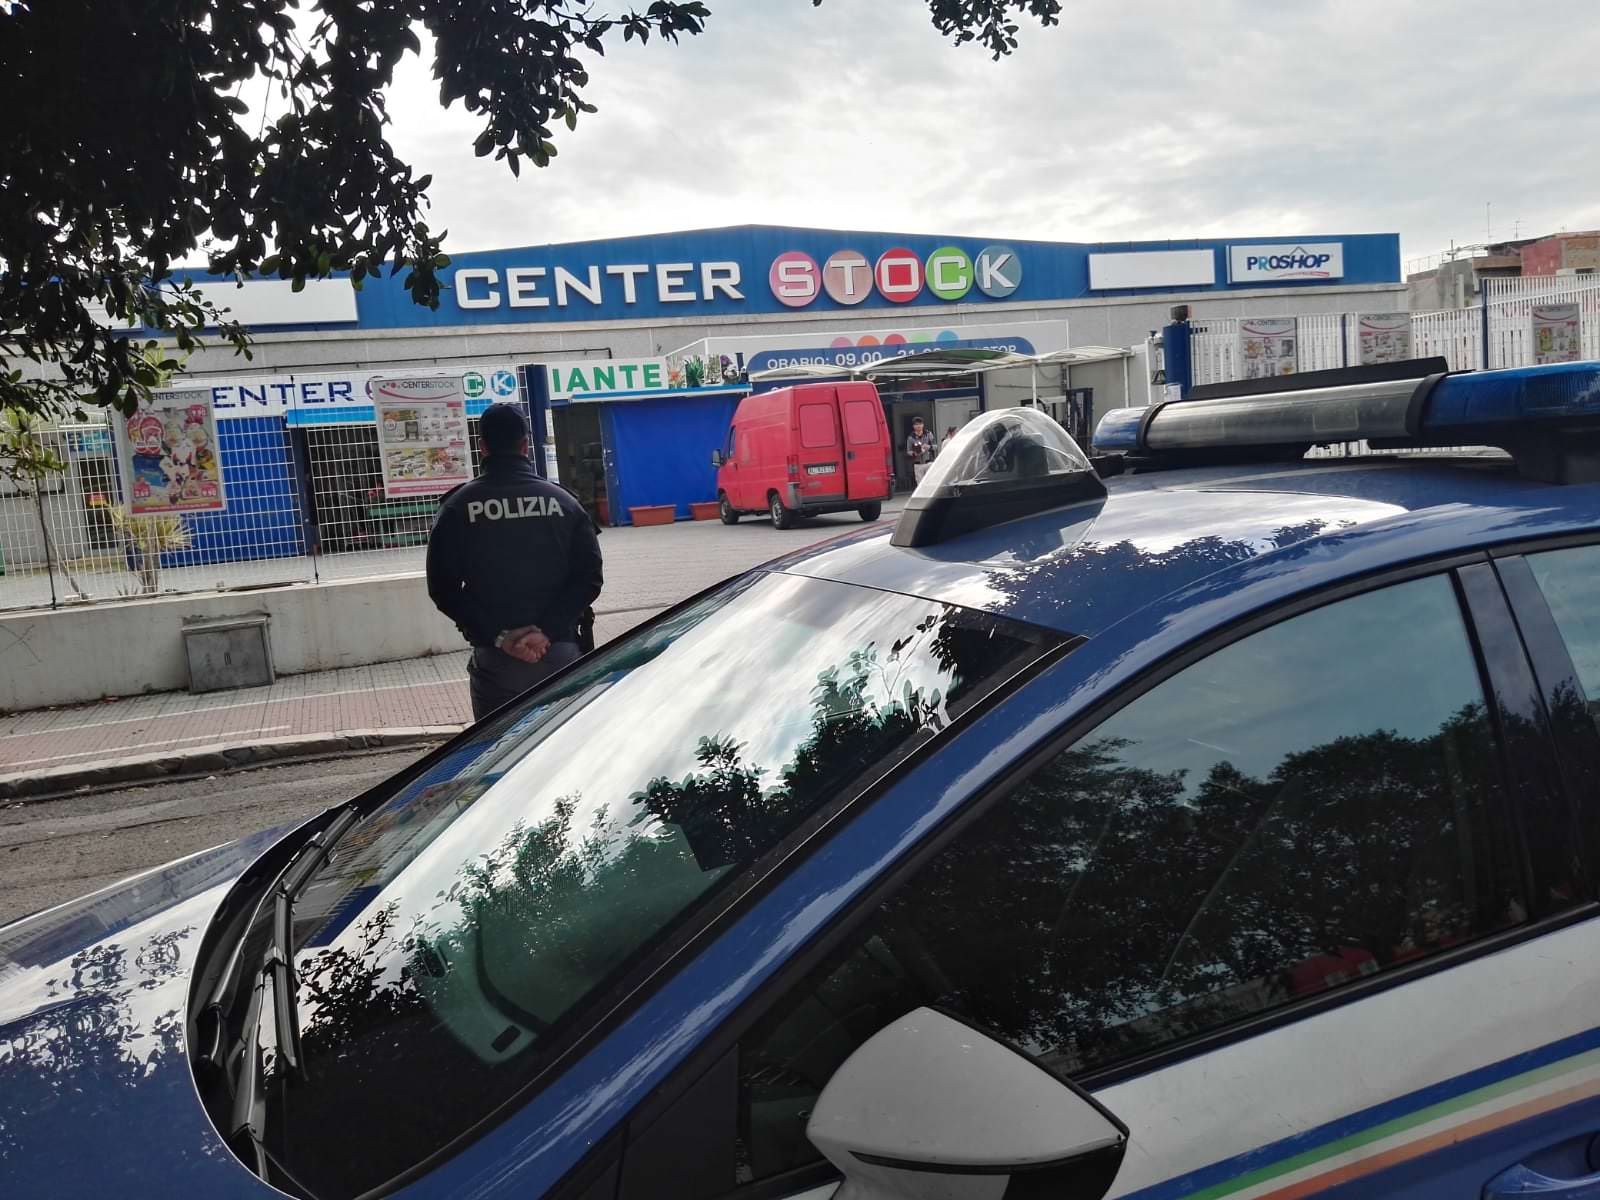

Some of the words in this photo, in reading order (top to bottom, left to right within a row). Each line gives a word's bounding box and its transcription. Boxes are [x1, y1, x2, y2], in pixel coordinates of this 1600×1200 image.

[1246, 253, 1331, 271] PROSHOP
[454, 261, 746, 309] CENTER
[777, 253, 1017, 298] STOCK
[835, 351, 883, 366] 09.00
[552, 364, 662, 393] IANTE
[152, 391, 203, 401] ENTERSTOCK
[212, 381, 355, 409] ENTER
[467, 496, 565, 523] POLIZIA
